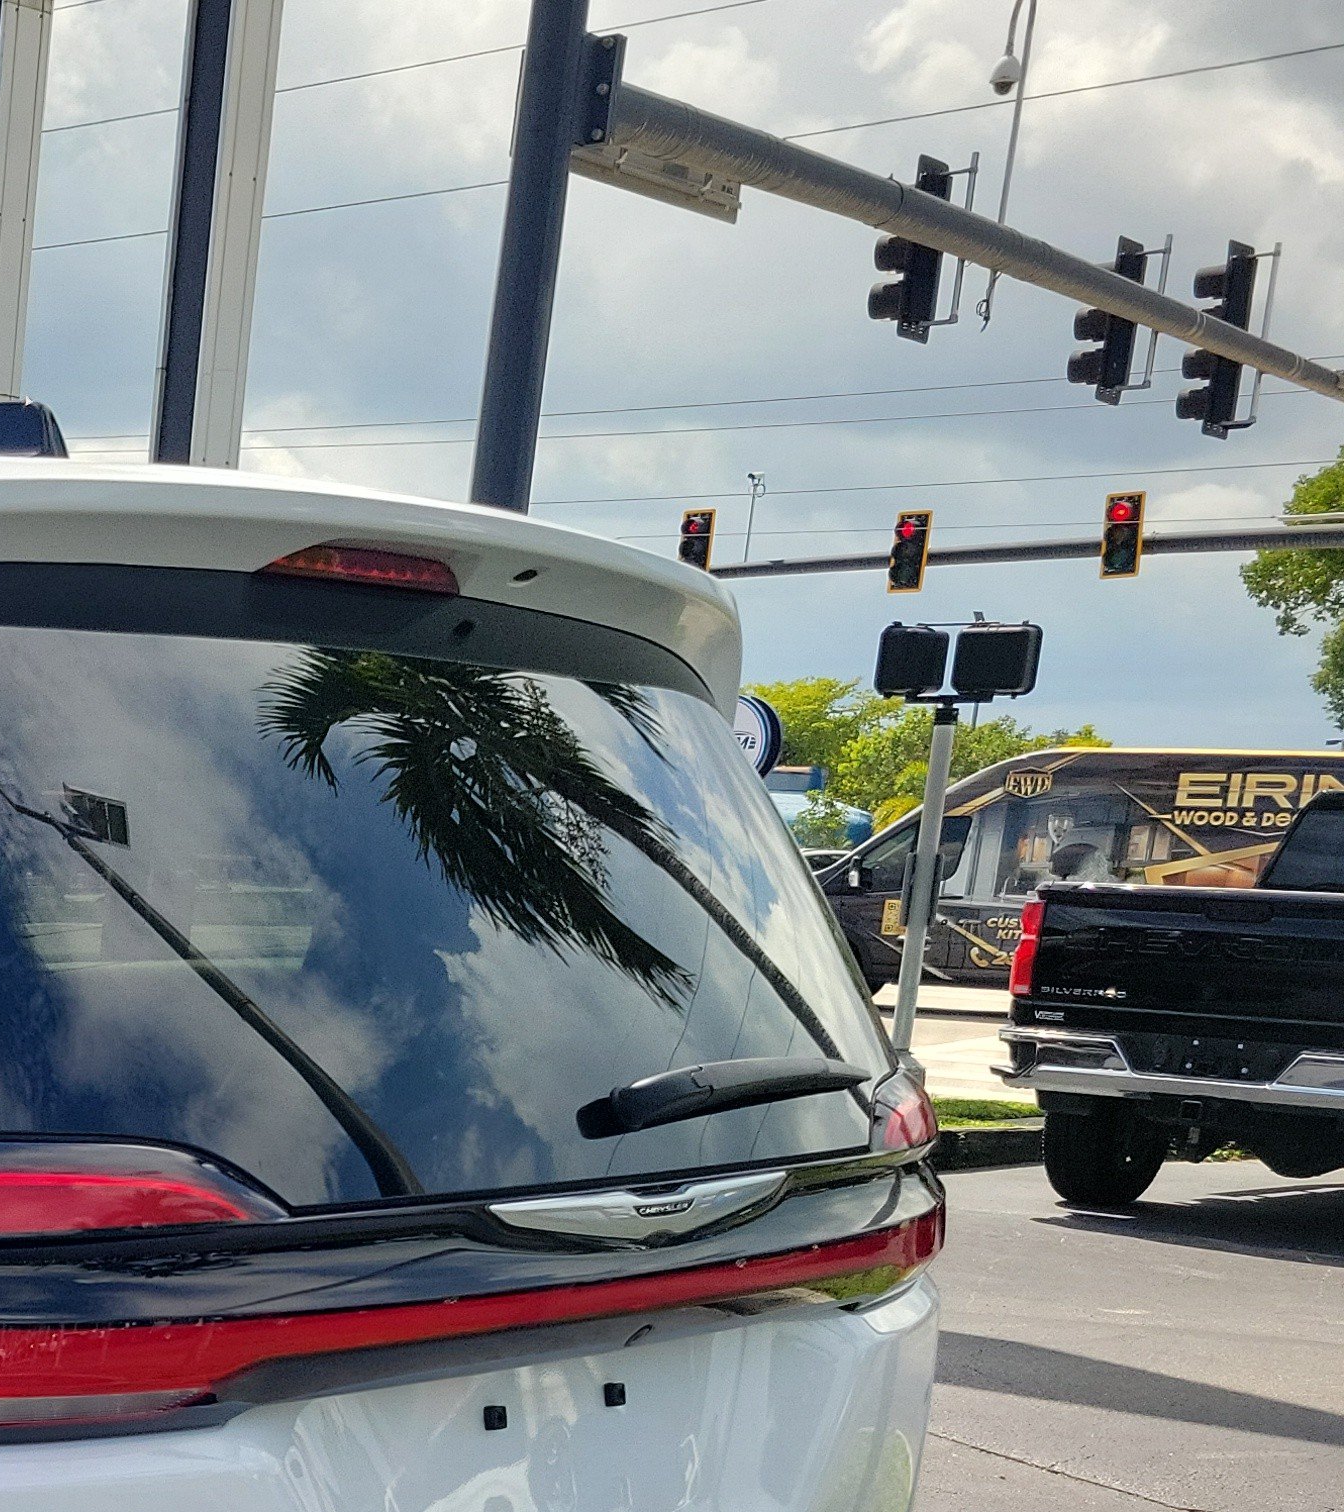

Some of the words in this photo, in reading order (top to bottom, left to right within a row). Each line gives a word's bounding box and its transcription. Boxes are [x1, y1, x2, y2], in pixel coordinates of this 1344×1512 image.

[1173, 811, 1238, 826] WOOD
[1242, 812, 1257, 826] &
[986, 917, 1023, 928] CUS
[996, 929, 1022, 940] KIT
